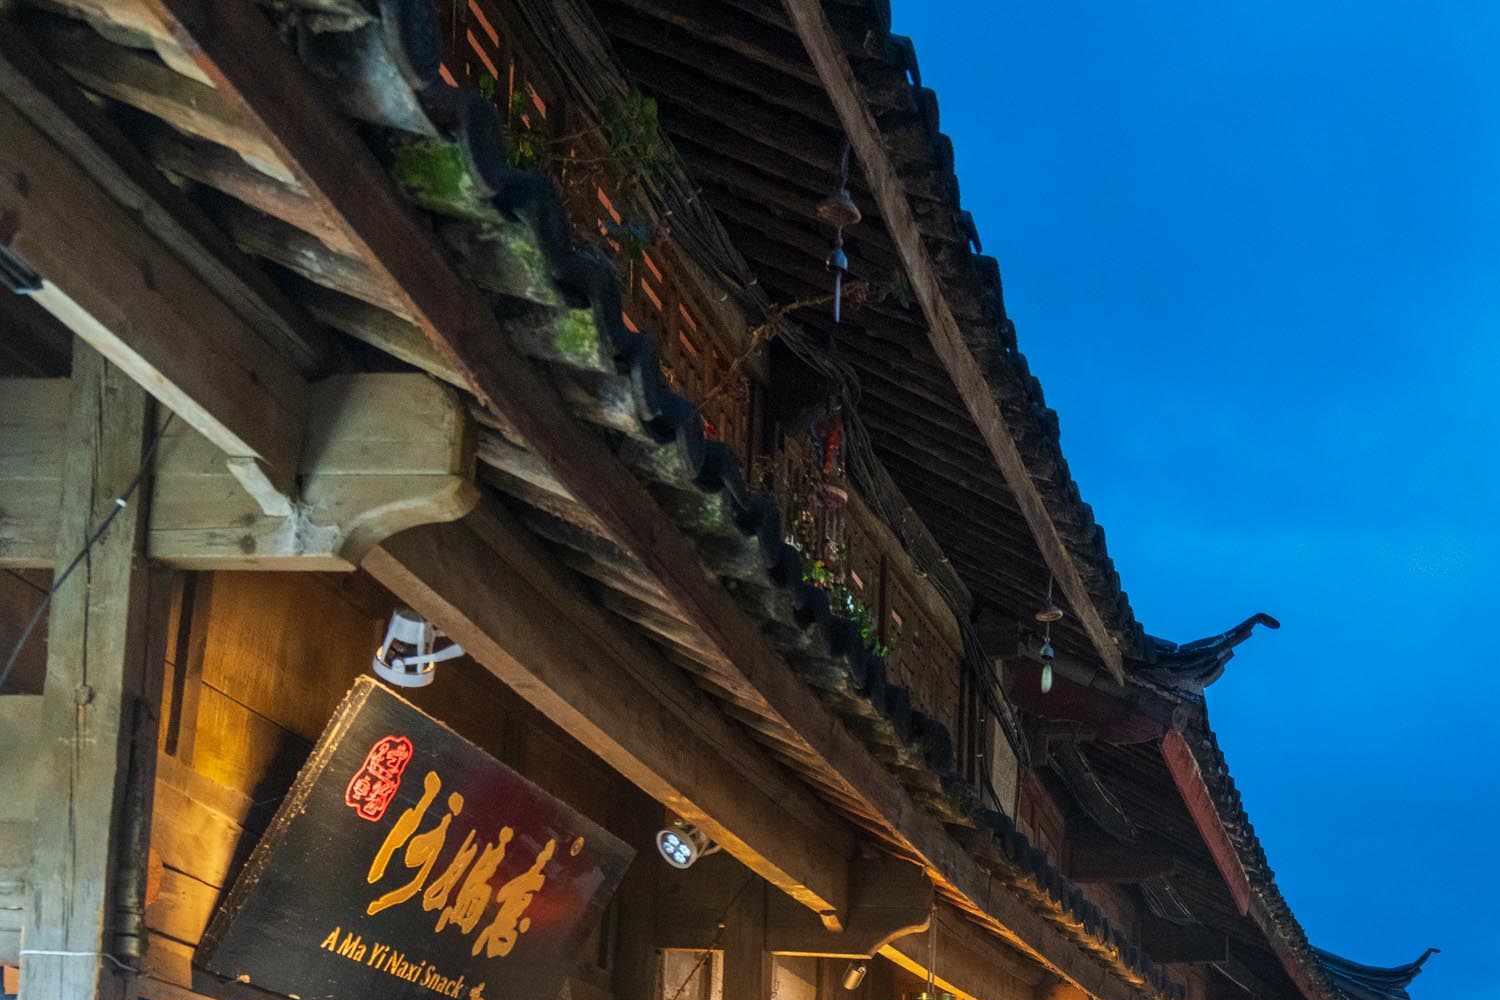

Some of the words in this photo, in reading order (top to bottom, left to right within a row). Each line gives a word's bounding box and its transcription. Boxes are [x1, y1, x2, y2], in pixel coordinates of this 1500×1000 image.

[320, 926, 341, 951] A
[336, 932, 367, 962] Ma
[367, 942, 391, 969] Yi
[383, 951, 426, 982] Naxi
[419, 965, 465, 999] Snack
